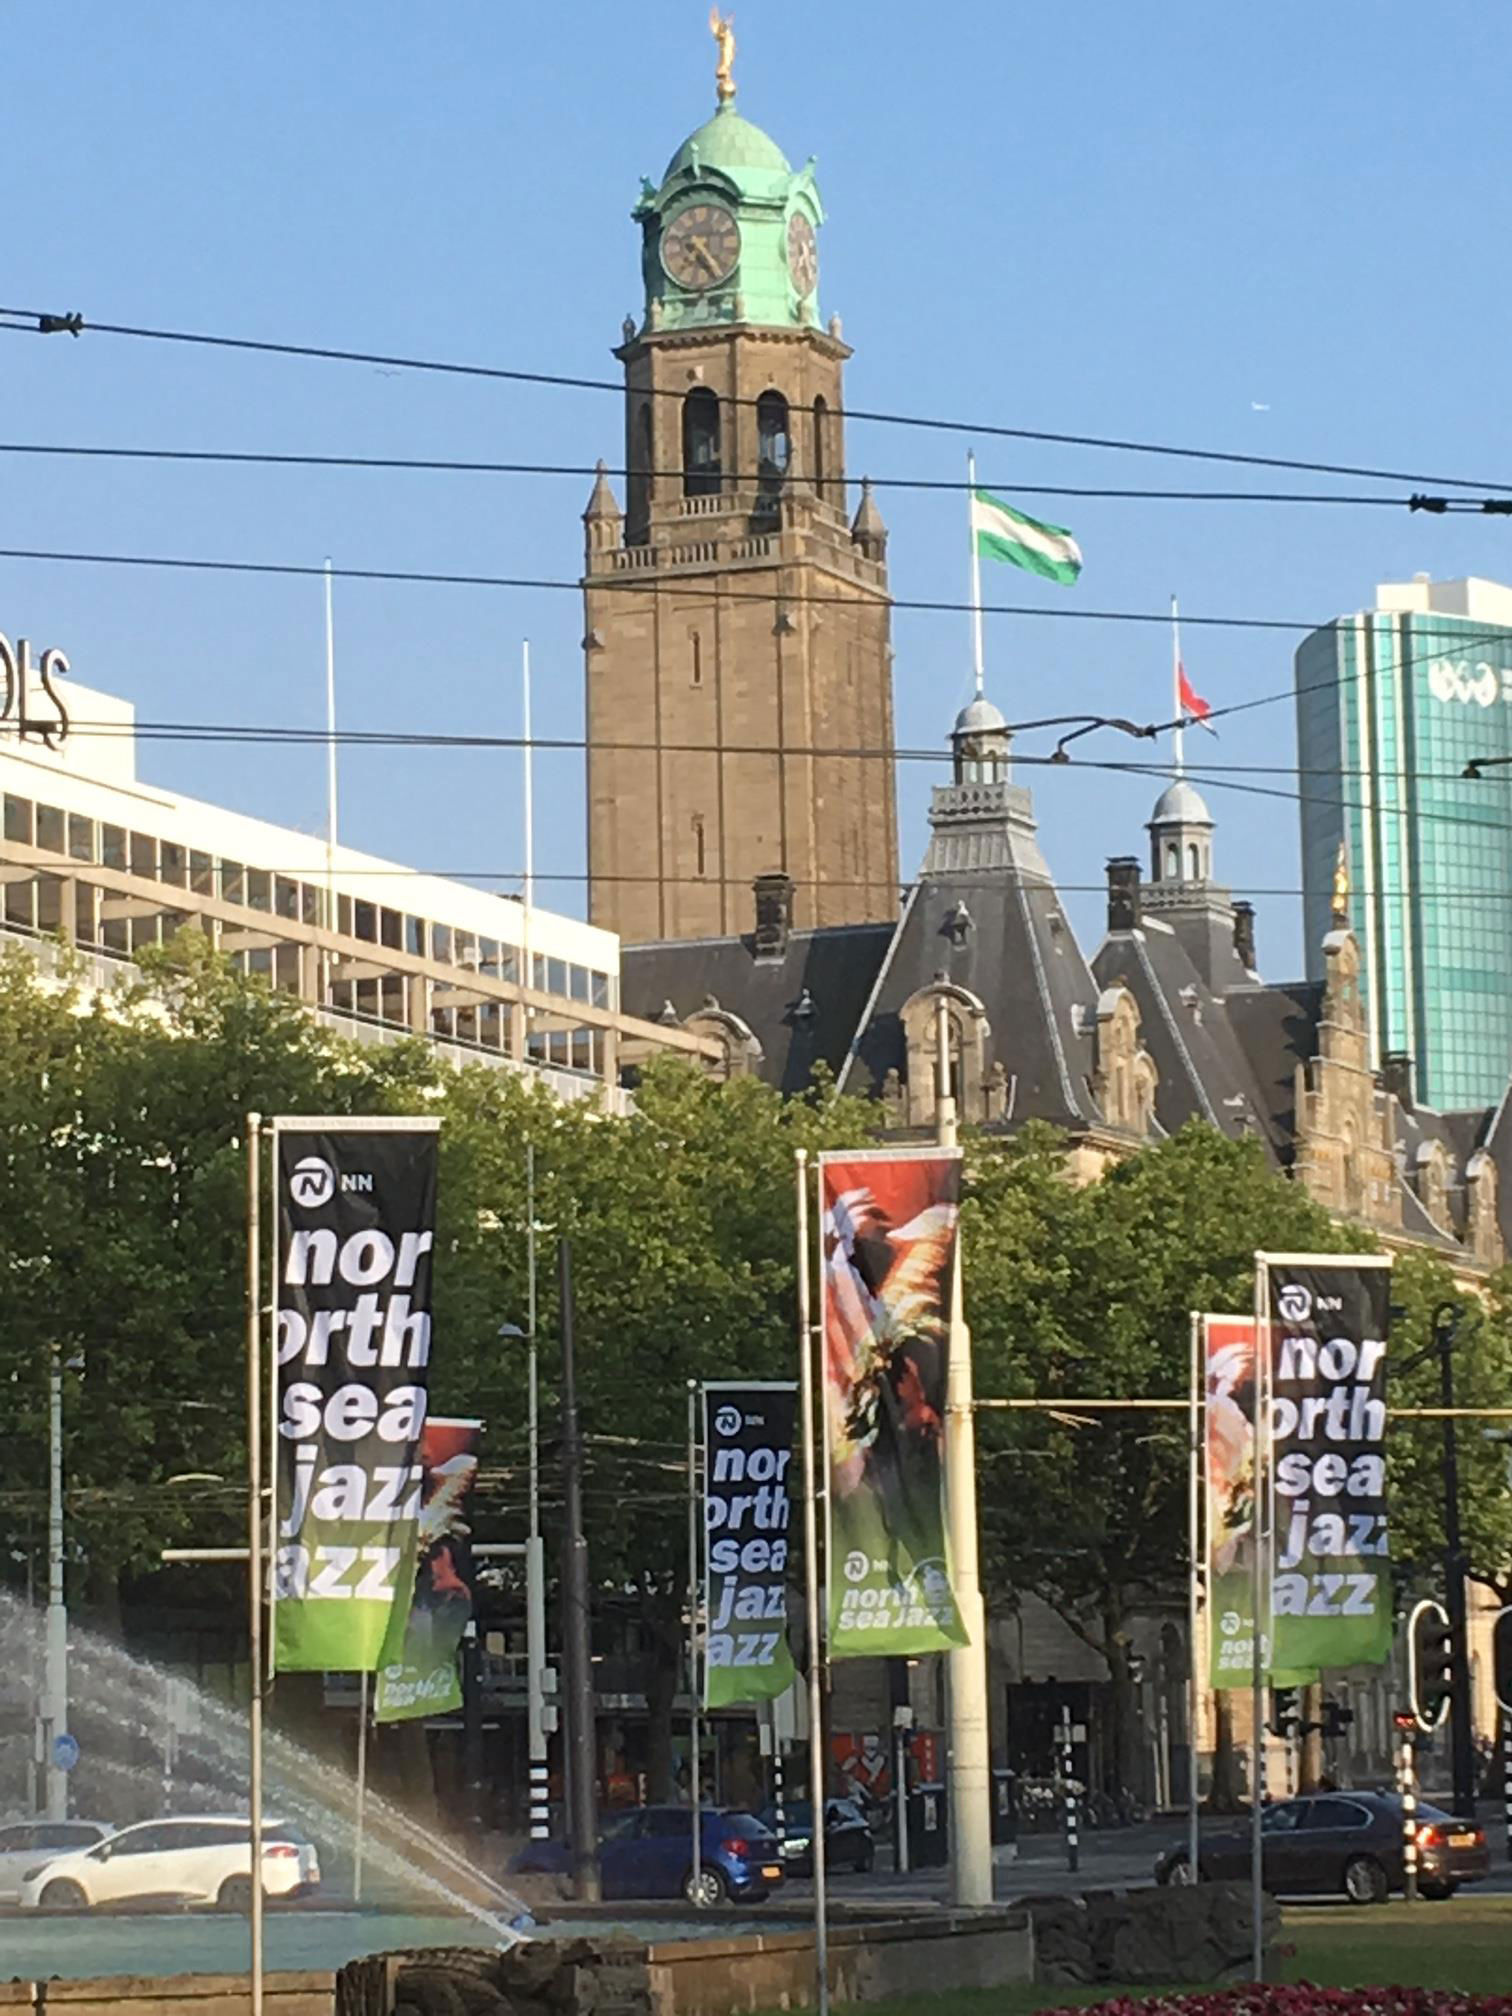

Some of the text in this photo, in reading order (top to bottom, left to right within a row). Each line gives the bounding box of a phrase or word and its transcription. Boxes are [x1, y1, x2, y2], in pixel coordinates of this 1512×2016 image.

[340, 1174, 373, 1192] NN
[284, 1228, 433, 1287] nor
[1315, 1297, 1343, 1312] NN
[277, 1293, 432, 1367] orth
[1278, 1335, 1387, 1382] nor
[279, 1382, 428, 1442] sea
[1272, 1386, 1387, 1441] orth
[712, 1448, 792, 1483] nor
[1274, 1452, 1386, 1498] sea
[706, 1485, 791, 1531] orth
[274, 1542, 401, 1602] azz
[709, 1538, 788, 1574] sea
[841, 1584, 920, 1609] north
[1273, 1572, 1377, 1617] azz
[838, 1606, 954, 1630] sea jazz
[706, 1632, 780, 1668] azz
